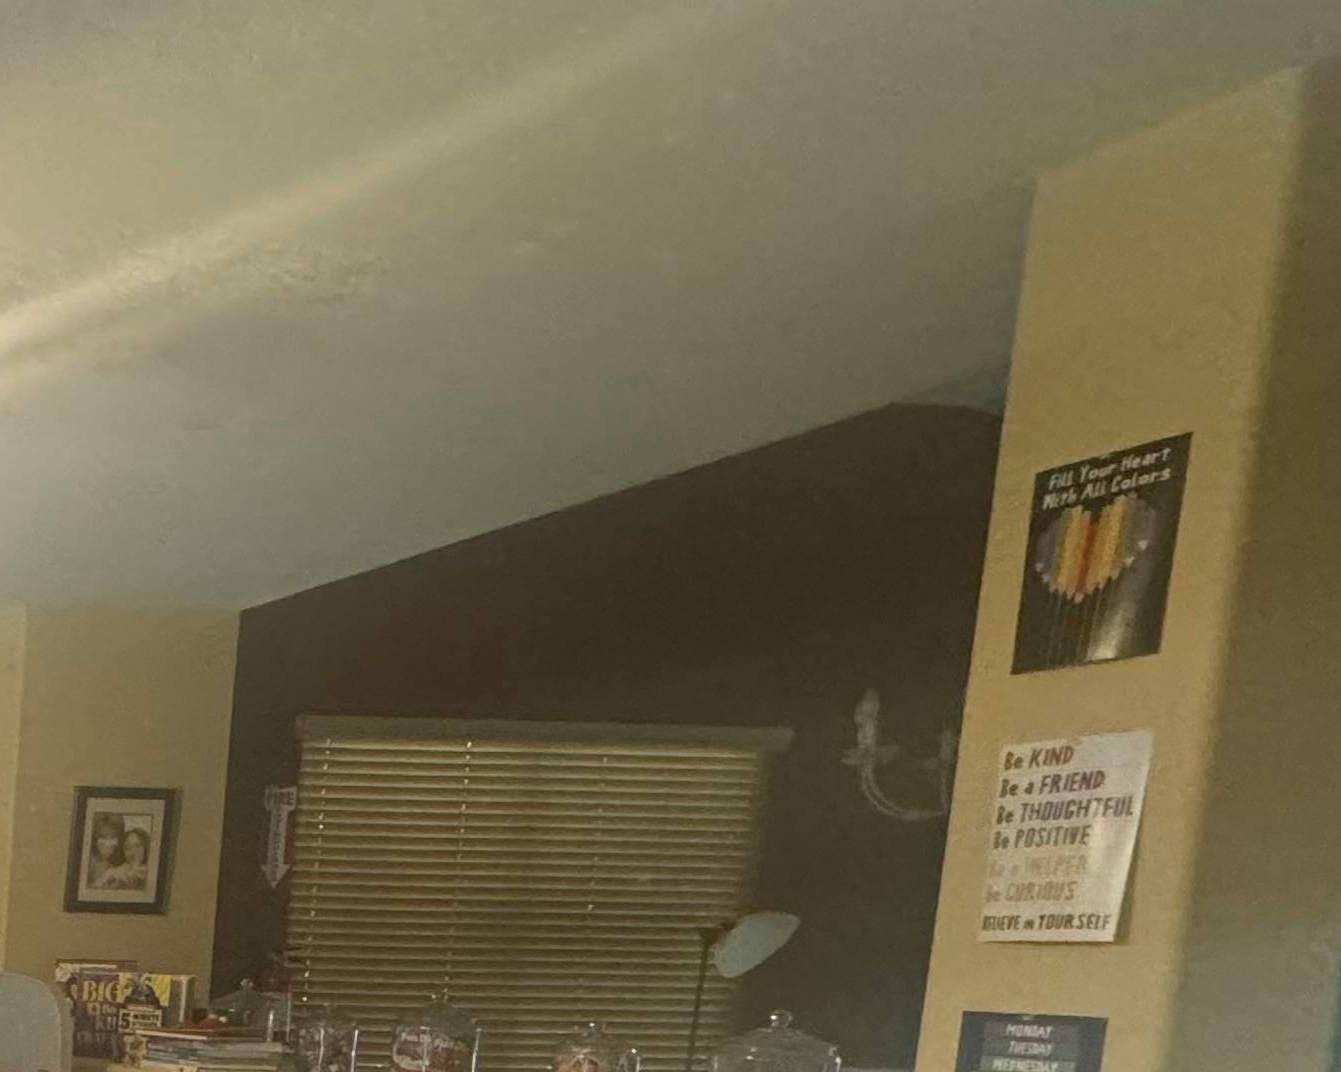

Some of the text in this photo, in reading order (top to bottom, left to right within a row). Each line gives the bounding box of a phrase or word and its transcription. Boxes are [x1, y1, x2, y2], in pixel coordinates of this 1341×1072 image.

[1048, 448, 1171, 491] Fill Your Heart
[1080, 483, 1106, 501] All
[1111, 467, 1171, 493] Colors
[1004, 745, 1075, 771] Be KIND
[999, 769, 1106, 798] Be a FRIEND
[996, 795, 1134, 825] Be THOUGHTFUL
[993, 824, 1092, 850] Be POSITIVE
[1005, 880, 1079, 902] CURIOUS
[82, 981, 119, 1002] BIG
[121, 1012, 131, 1030] 5
[1006, 1024, 1053, 1040] MONDAY
[1008, 1041, 1053, 1056] TUESDAY
